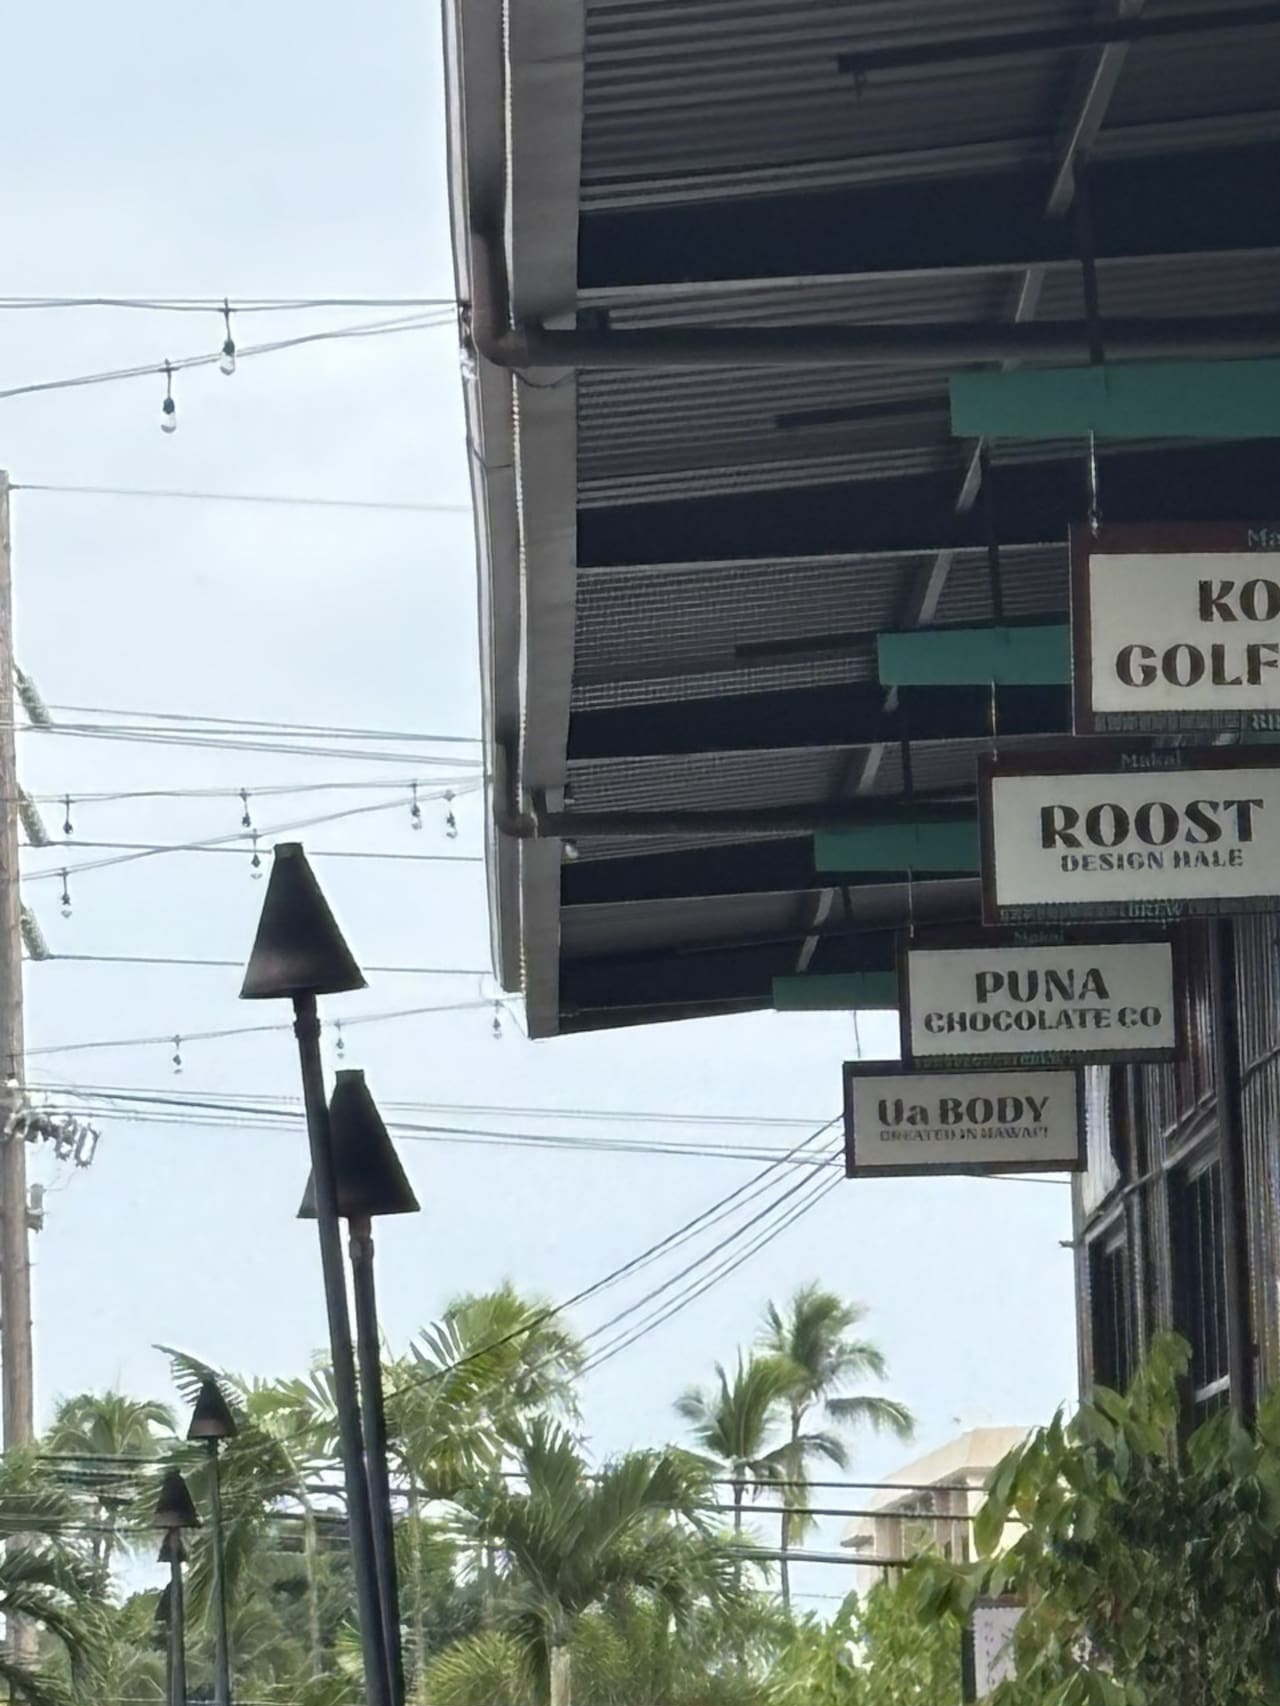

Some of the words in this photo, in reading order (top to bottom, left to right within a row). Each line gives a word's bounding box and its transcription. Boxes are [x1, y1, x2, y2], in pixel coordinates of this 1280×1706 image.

[1115, 643, 1280, 687] GOLF
[1041, 799, 1263, 849] ROOST
[1061, 851, 1164, 872] DESIGN
[1173, 848, 1244, 869] HALE
[975, 968, 1110, 1003] PUNA
[924, 1007, 1111, 1033] CHOCOLATE
[1117, 1006, 1162, 1029] CO
[878, 1098, 929, 1126] Ua
[938, 1096, 1050, 1125] BODY
